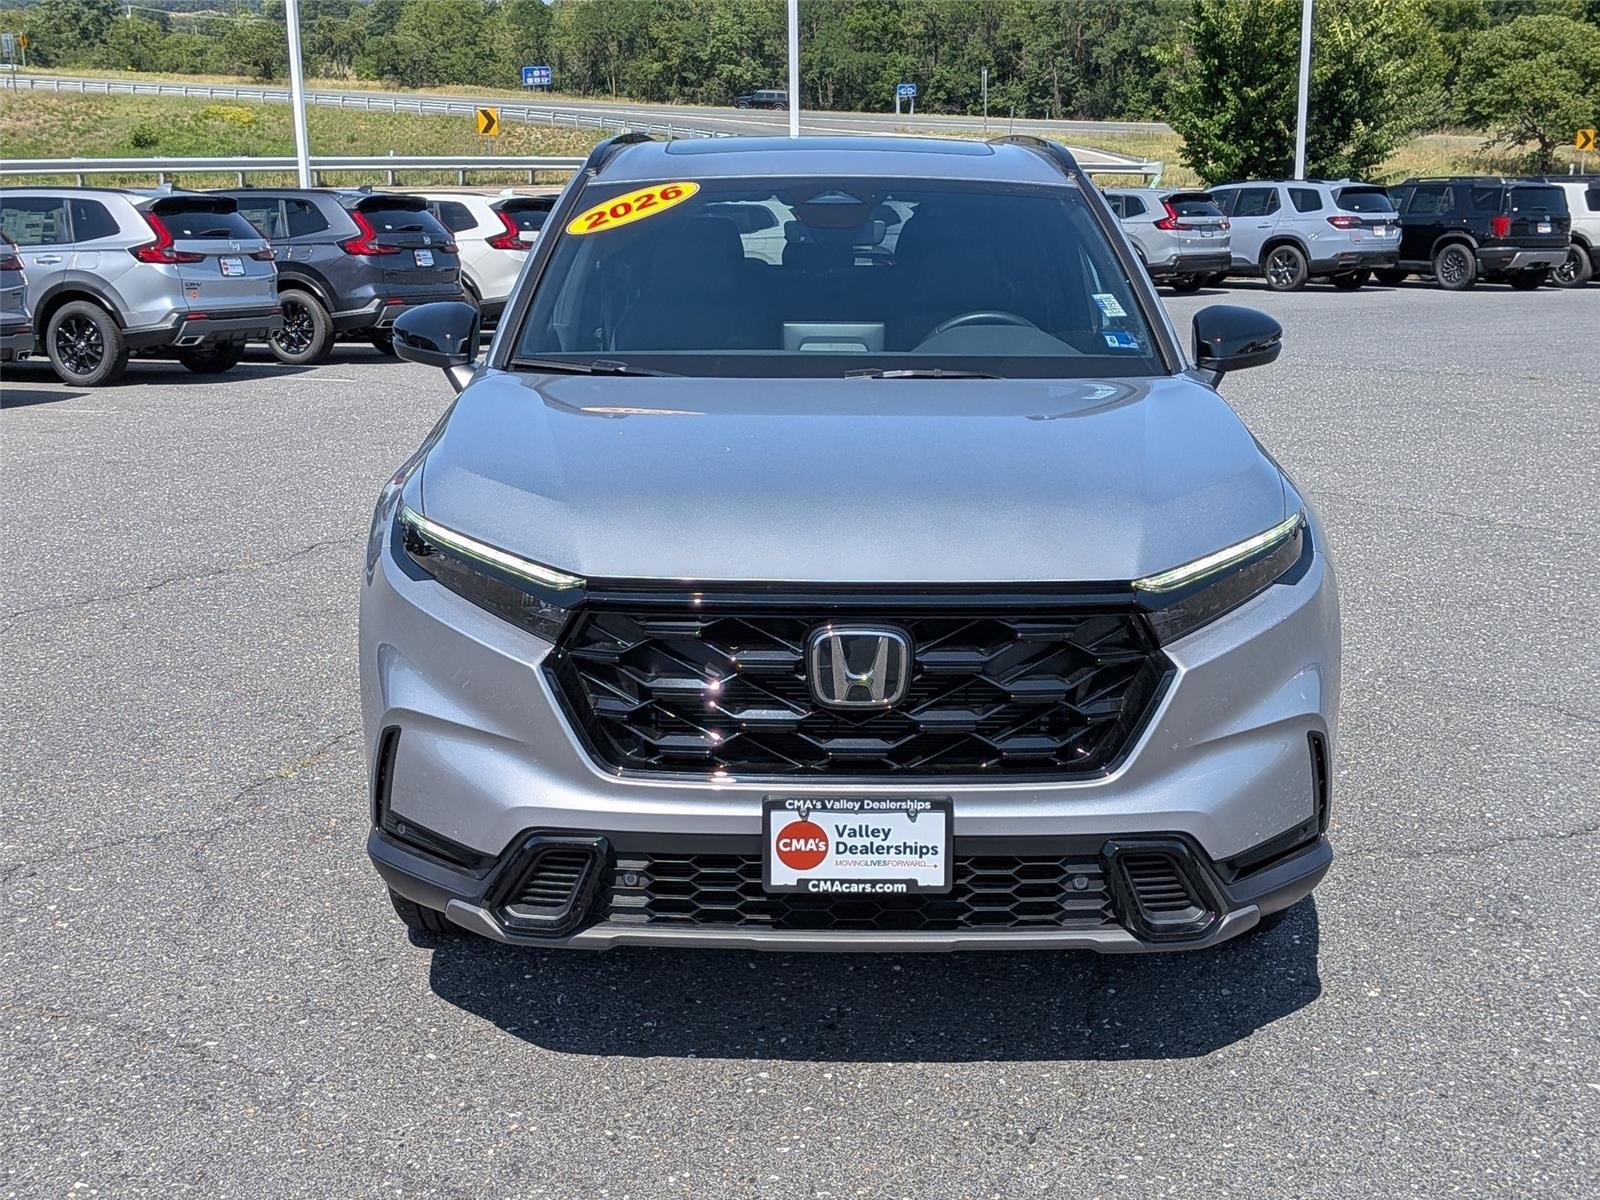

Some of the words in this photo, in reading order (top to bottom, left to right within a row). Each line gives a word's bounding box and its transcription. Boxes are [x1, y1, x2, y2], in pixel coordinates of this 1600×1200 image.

[584, 186, 683, 230] 2026
[785, 799, 822, 810] CMA's
[825, 799, 861, 811] Valley
[864, 799, 932, 811] Dealerships
[834, 824, 892, 841] Valley
[778, 837, 827, 853] CMA's
[835, 841, 939, 858] Dealerships
[808, 880, 908, 893] CMAcars.com
